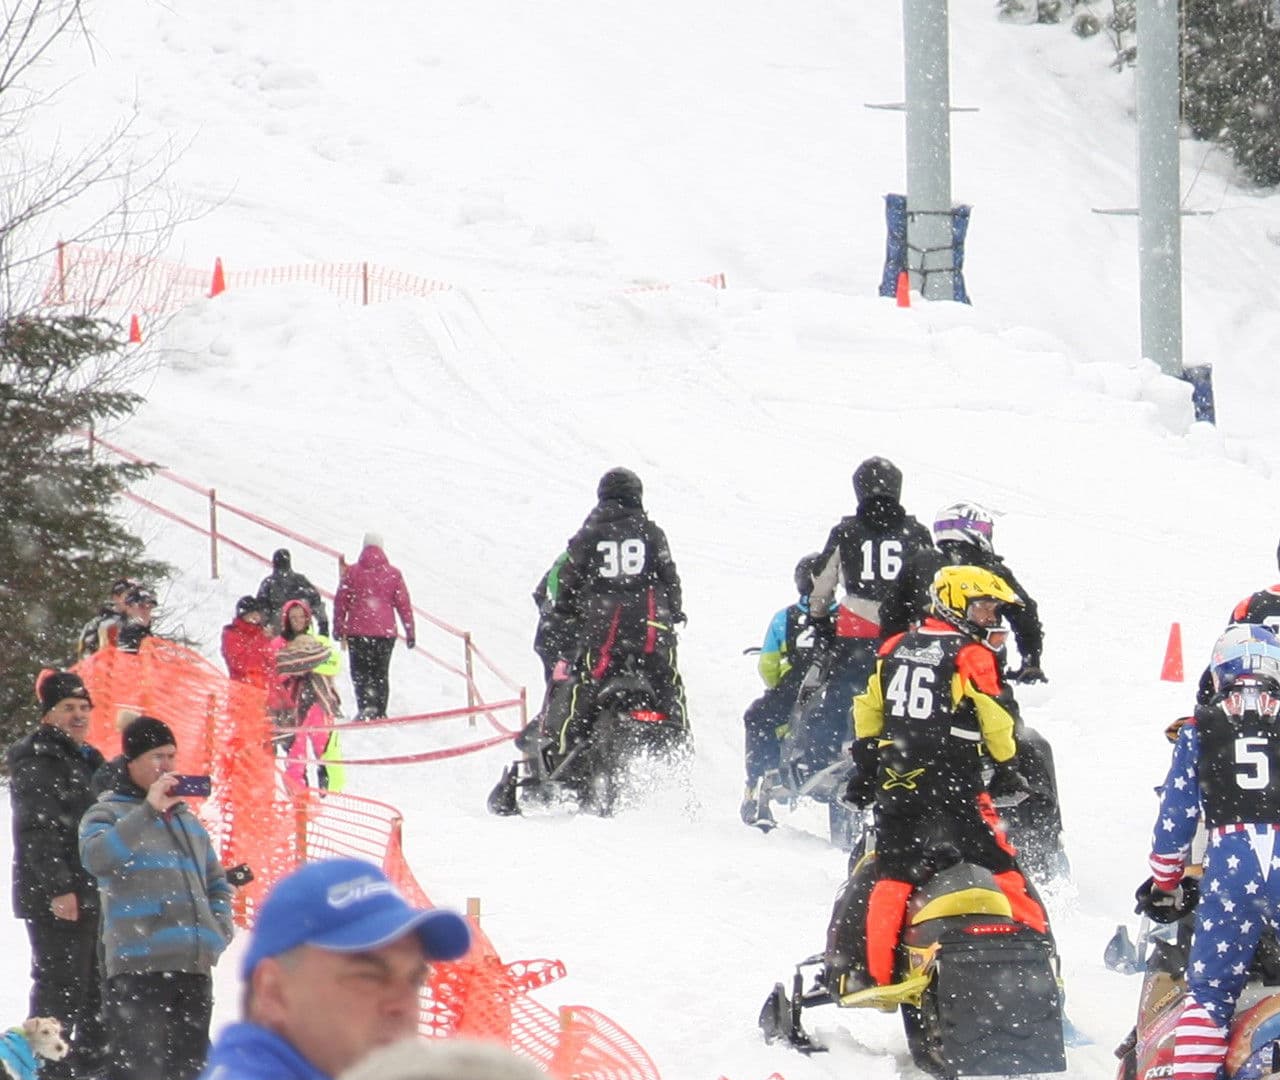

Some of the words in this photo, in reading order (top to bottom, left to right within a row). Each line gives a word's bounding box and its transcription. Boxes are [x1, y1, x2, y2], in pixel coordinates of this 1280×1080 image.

[597, 539, 645, 577] 38
[861, 540, 902, 580] 16
[886, 664, 936, 719] 46
[1235, 737, 1269, 790] 5
